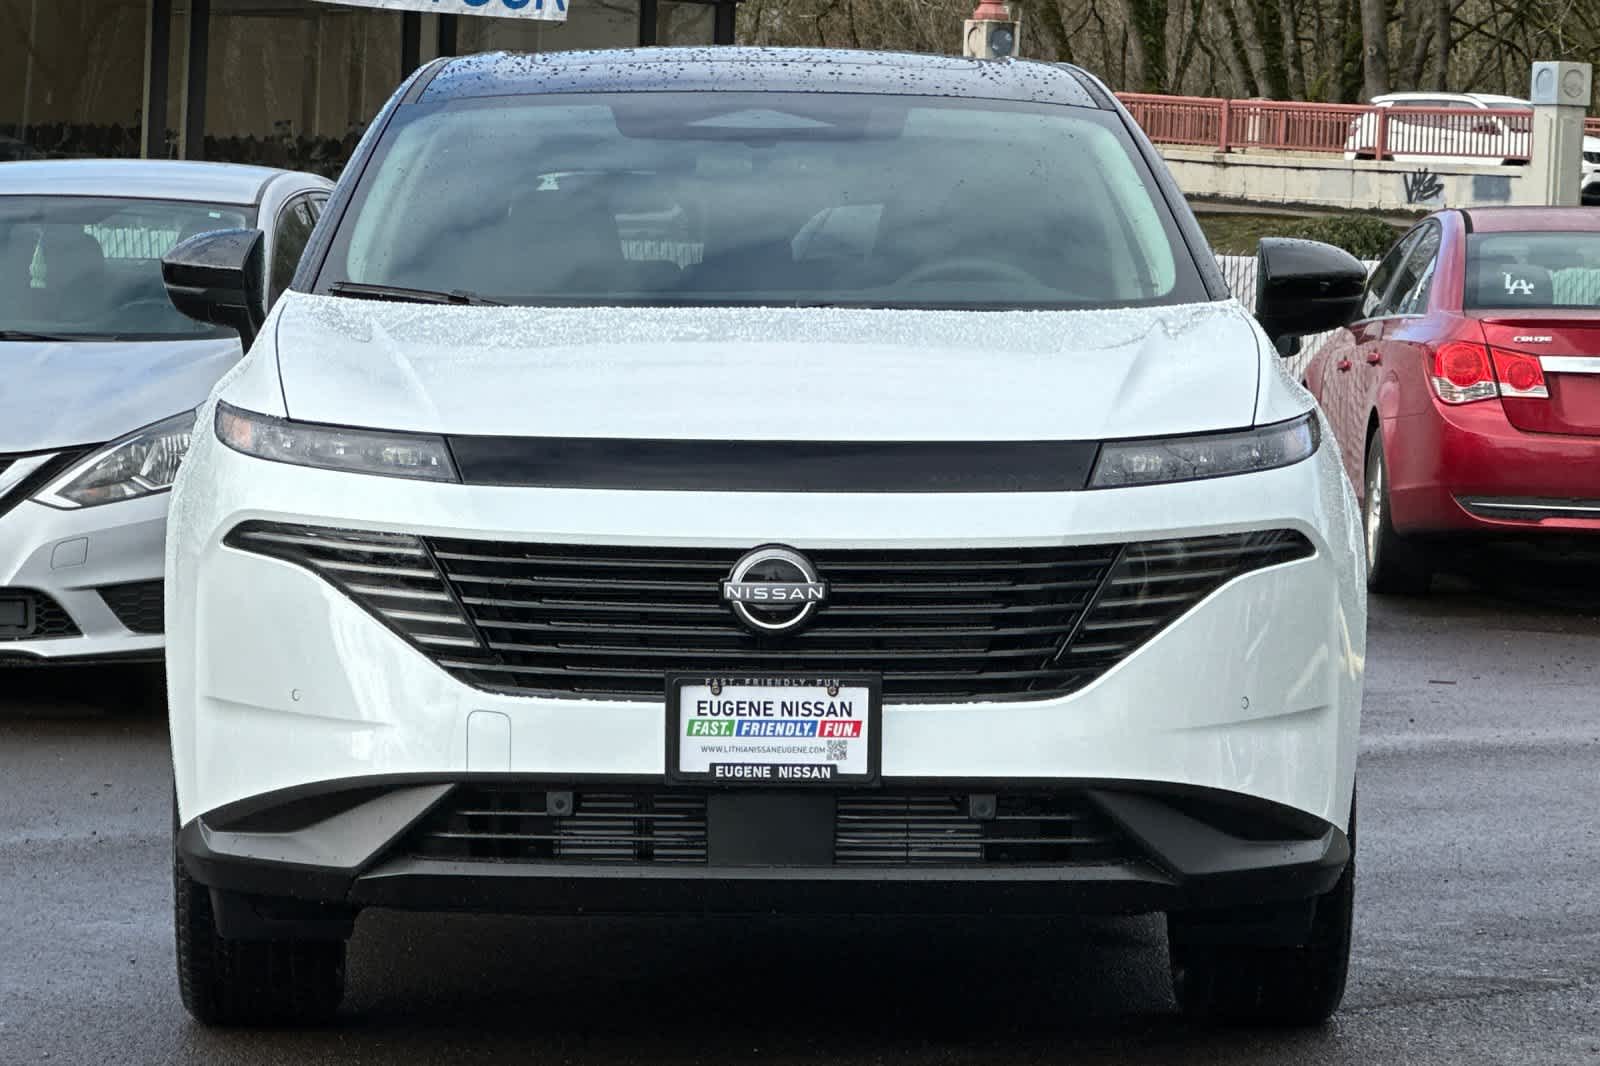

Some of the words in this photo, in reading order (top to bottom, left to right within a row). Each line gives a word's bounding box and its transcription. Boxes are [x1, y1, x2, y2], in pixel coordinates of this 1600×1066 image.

[726, 586, 823, 600] NISSAN
[697, 700, 774, 717] EUGENE
[780, 701, 853, 718] NISSAN
[692, 721, 730, 735] FAST.
[741, 722, 814, 736] FRIENDLY.
[823, 723, 858, 736] FUN.
[700, 745, 826, 754] WWW.LITHIANISSANEUGENE.COM
[715, 765, 771, 778] EUGENE
[778, 766, 831, 779] NISSAN
